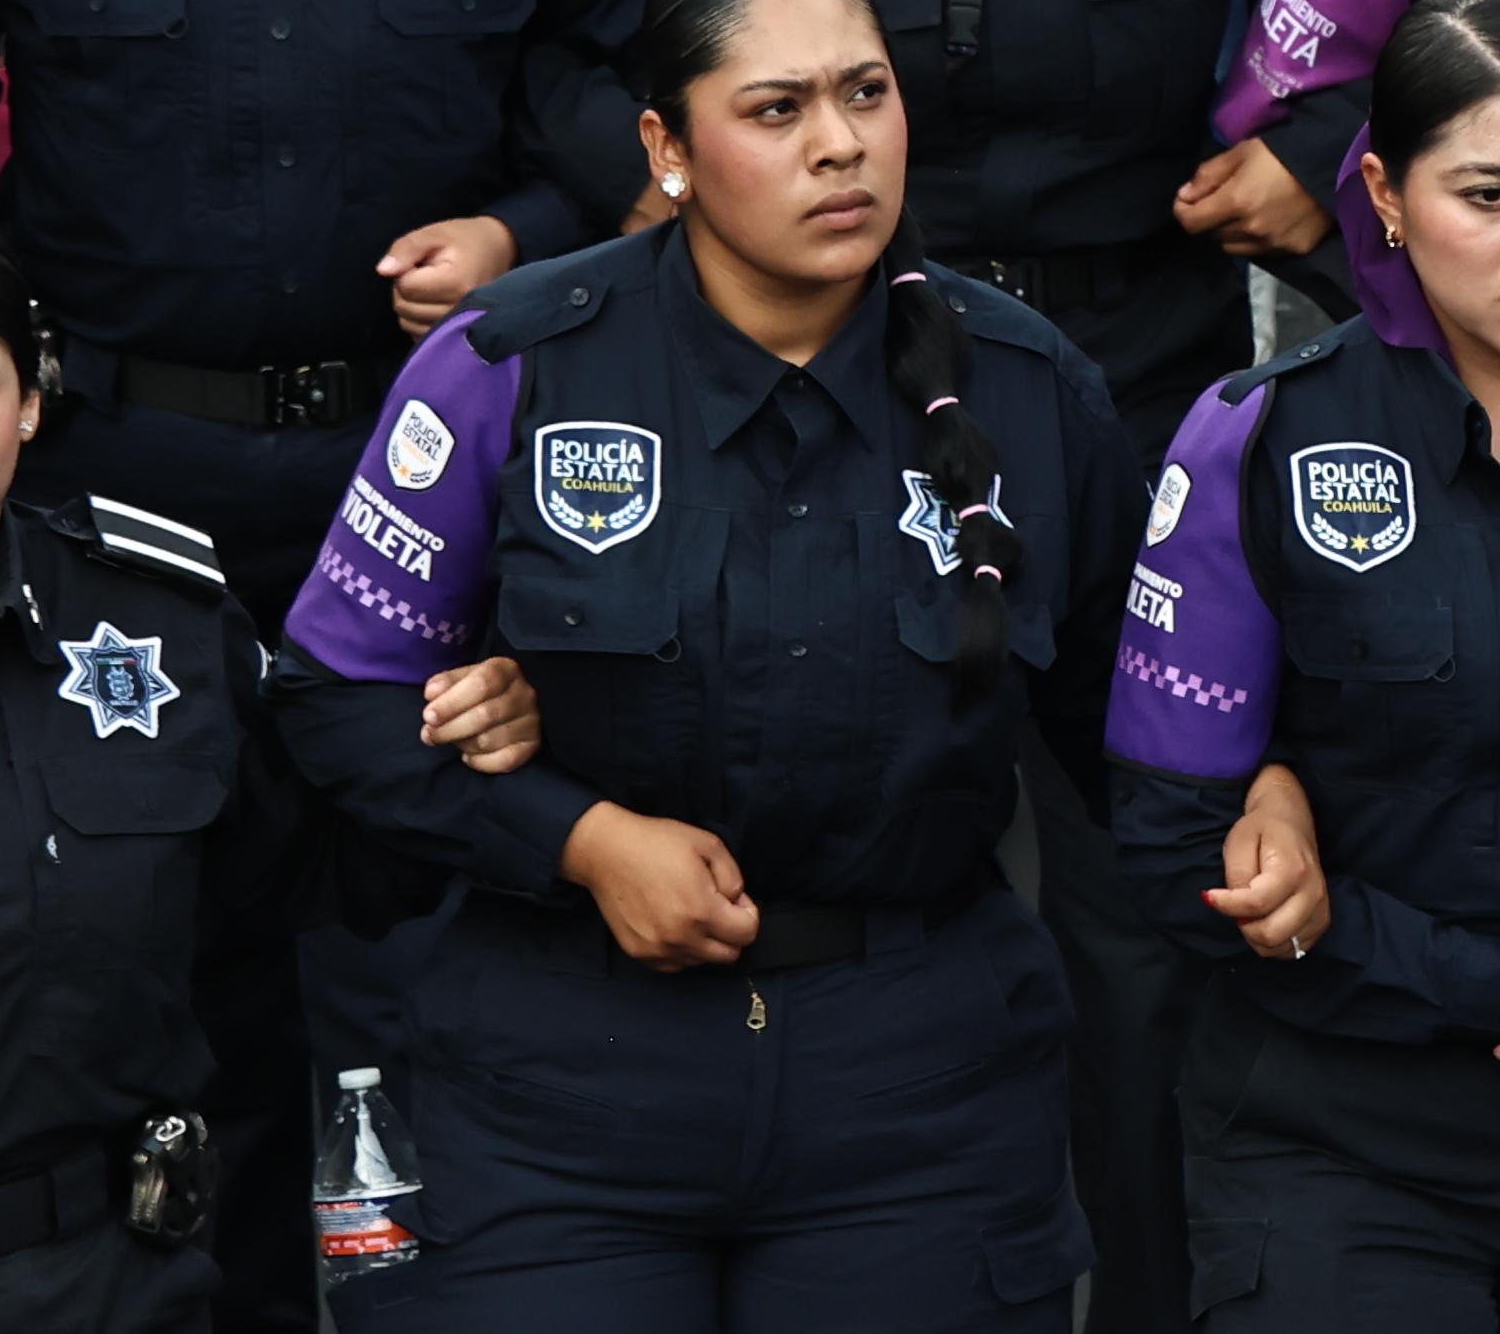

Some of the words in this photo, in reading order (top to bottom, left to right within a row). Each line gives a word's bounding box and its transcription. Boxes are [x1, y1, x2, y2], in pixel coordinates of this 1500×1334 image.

[402, 424, 437, 461] ESTATAL
[551, 438, 644, 463] POLICÍA
[551, 459, 645, 482] ESTATAL
[1308, 459, 1399, 485] POLICÍA
[562, 478, 634, 493] COAHUILA
[1309, 481, 1401, 503] ESTATAL
[1322, 501, 1392, 514] COAHUILA
[342, 487, 432, 582] VIOLETA
